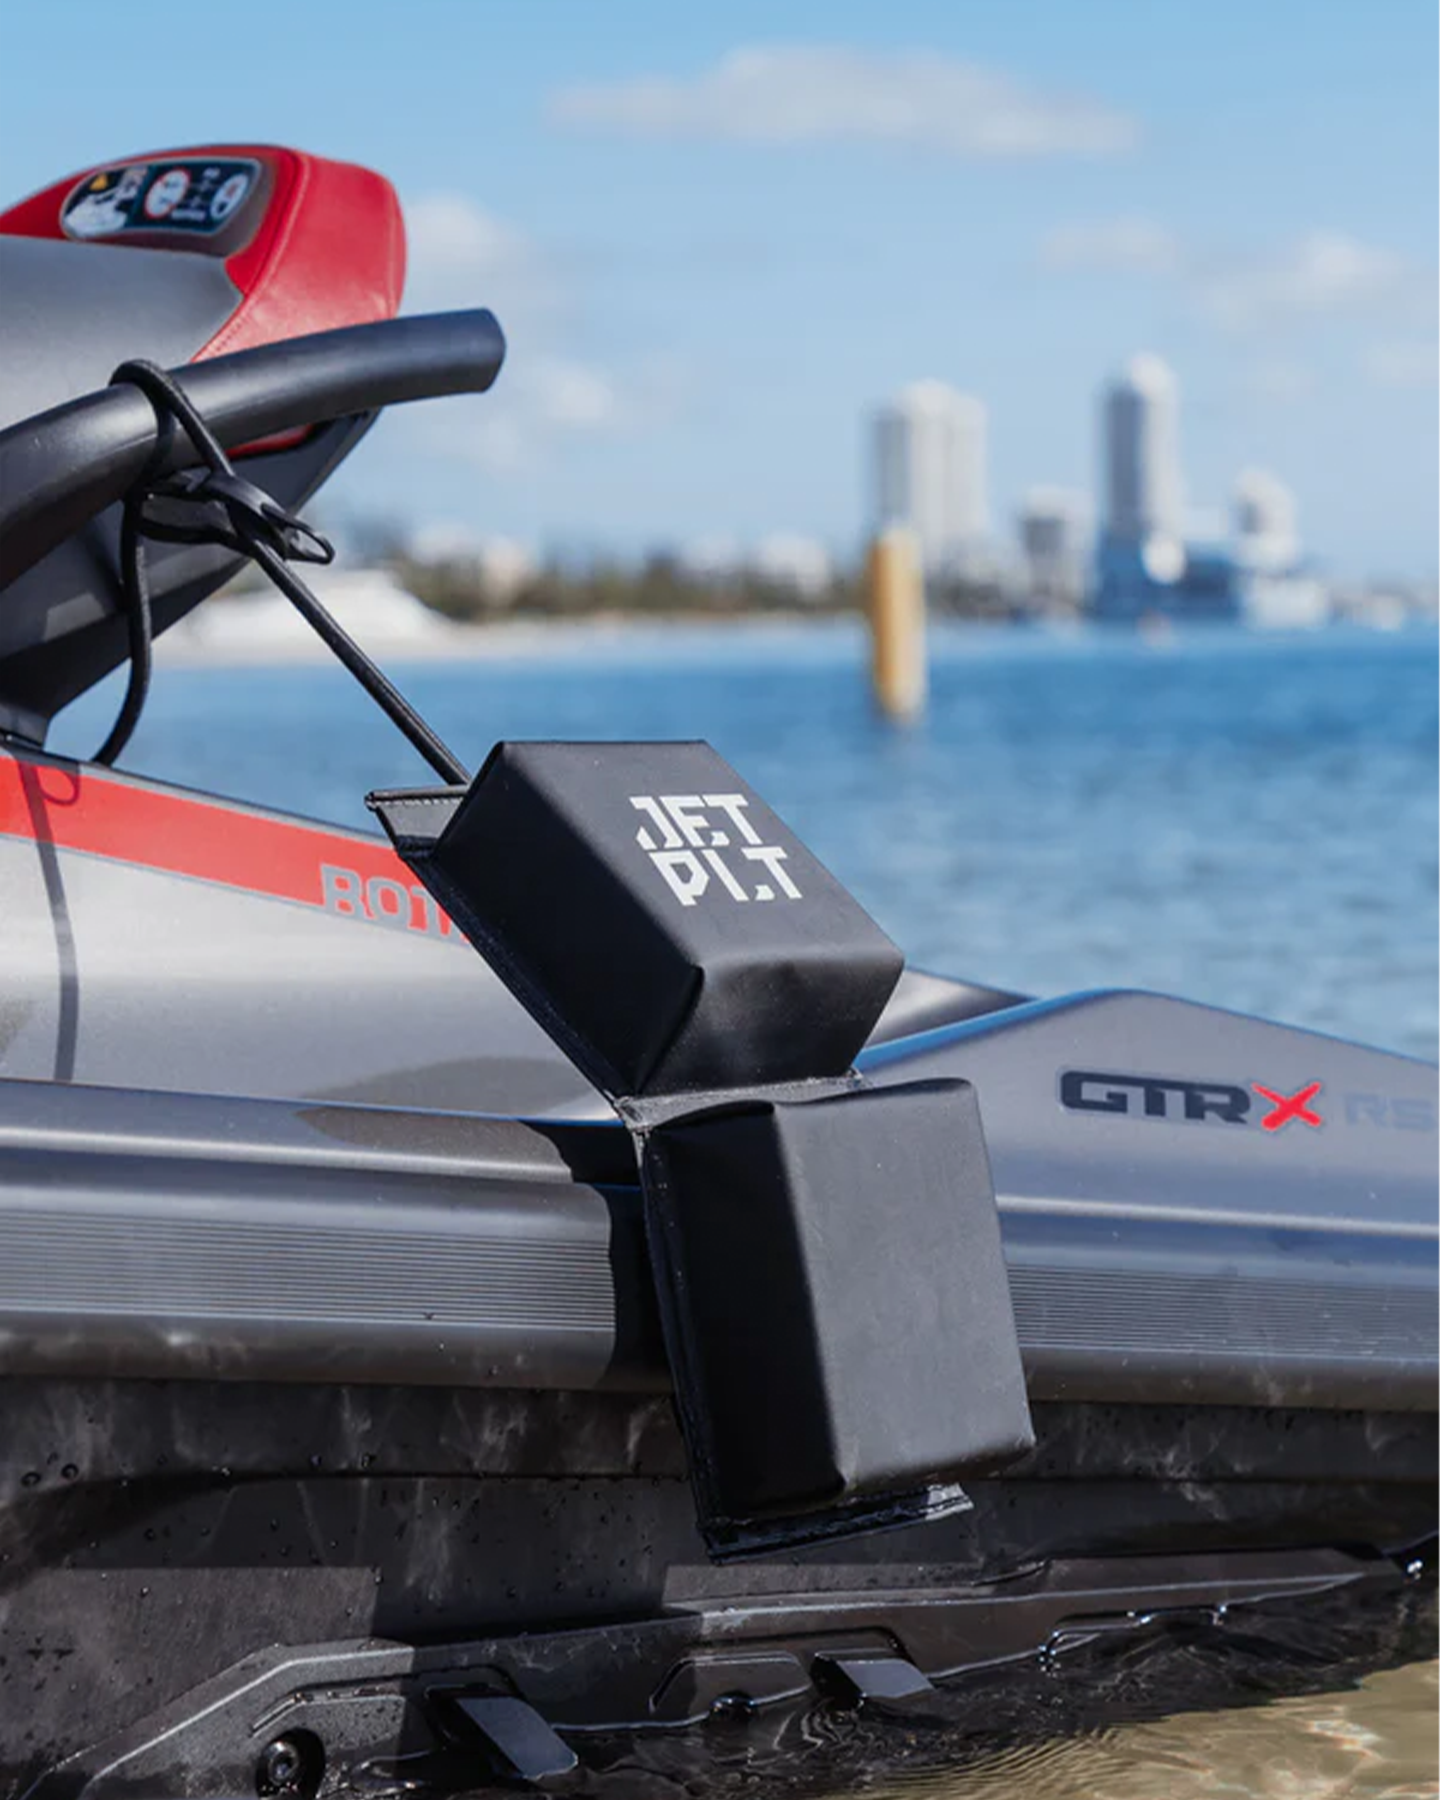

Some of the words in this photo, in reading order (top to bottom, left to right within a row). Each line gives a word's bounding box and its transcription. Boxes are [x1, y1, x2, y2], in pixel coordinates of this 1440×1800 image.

[629, 794, 763, 850] JET
[320, 862, 470, 946] ROT
[648, 846, 803, 906] PLT
